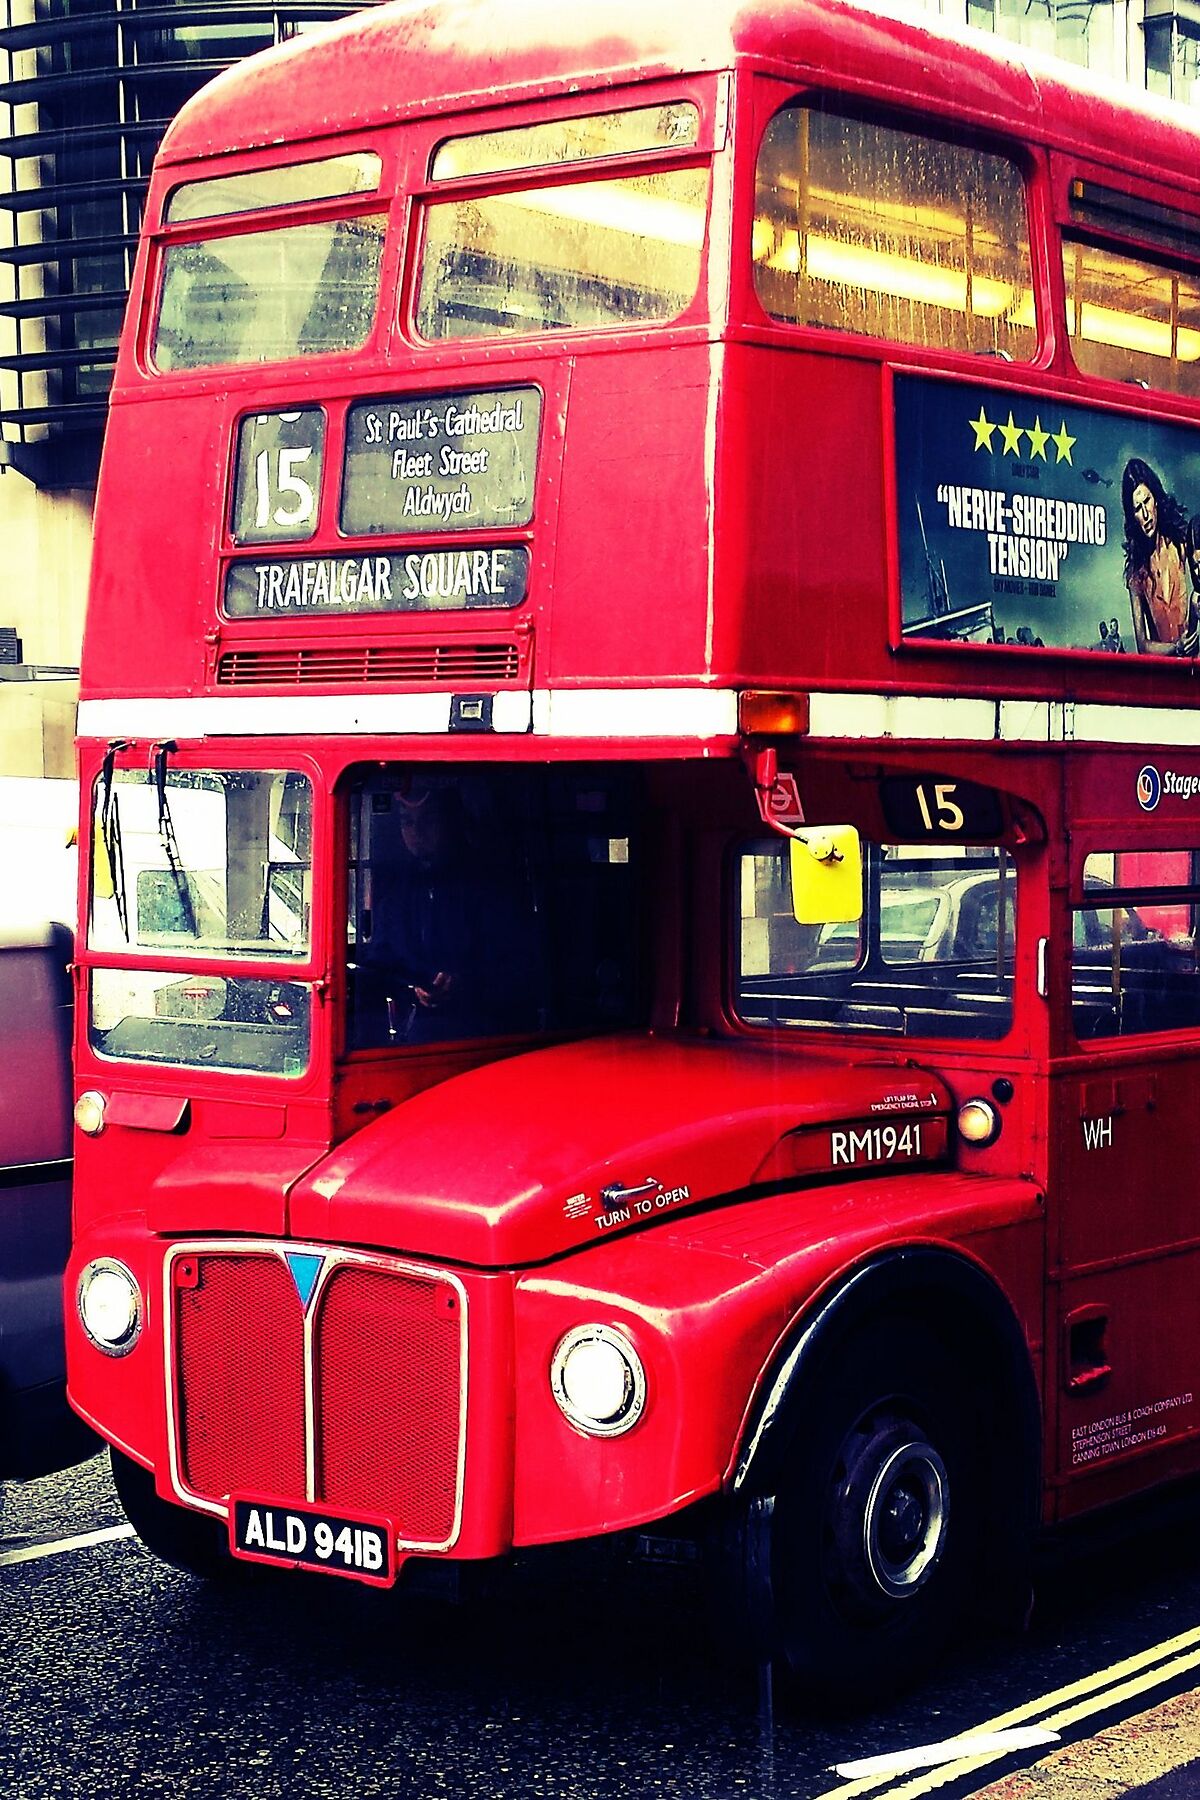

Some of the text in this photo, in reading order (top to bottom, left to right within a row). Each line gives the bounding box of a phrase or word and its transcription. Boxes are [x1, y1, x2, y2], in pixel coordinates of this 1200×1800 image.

[365, 400, 524, 443] St Paul's Cathedral
[392, 445, 490, 480] Fleet Street
[254, 445, 315, 528] 15
[402, 482, 472, 522] Aldwych
[255, 549, 506, 608] TRAFALGAR SQUARE
[916, 784, 964, 830] 15
[831, 1124, 921, 1165] RM1941
[1083, 1116, 1112, 1150] WH
[594, 1207, 631, 1229] TURN
[633, 1200, 653, 1215] TO
[655, 1185, 690, 1208] OPEN
[1072, 1425, 1088, 1439] EAST
[1088, 1417, 1115, 1434] LONDON
[1132, 1404, 1154, 1420] COACH
[1154, 1397, 1181, 1413] COMPANY
[1072, 1423, 1132, 1452] STEPHENSON STREET
[1072, 1446, 1100, 1464] CANNING
[1101, 1441, 1120, 1455] TOWN
[1121, 1432, 1147, 1448] LONDON
[245, 1509, 383, 1570] ALD 941B
